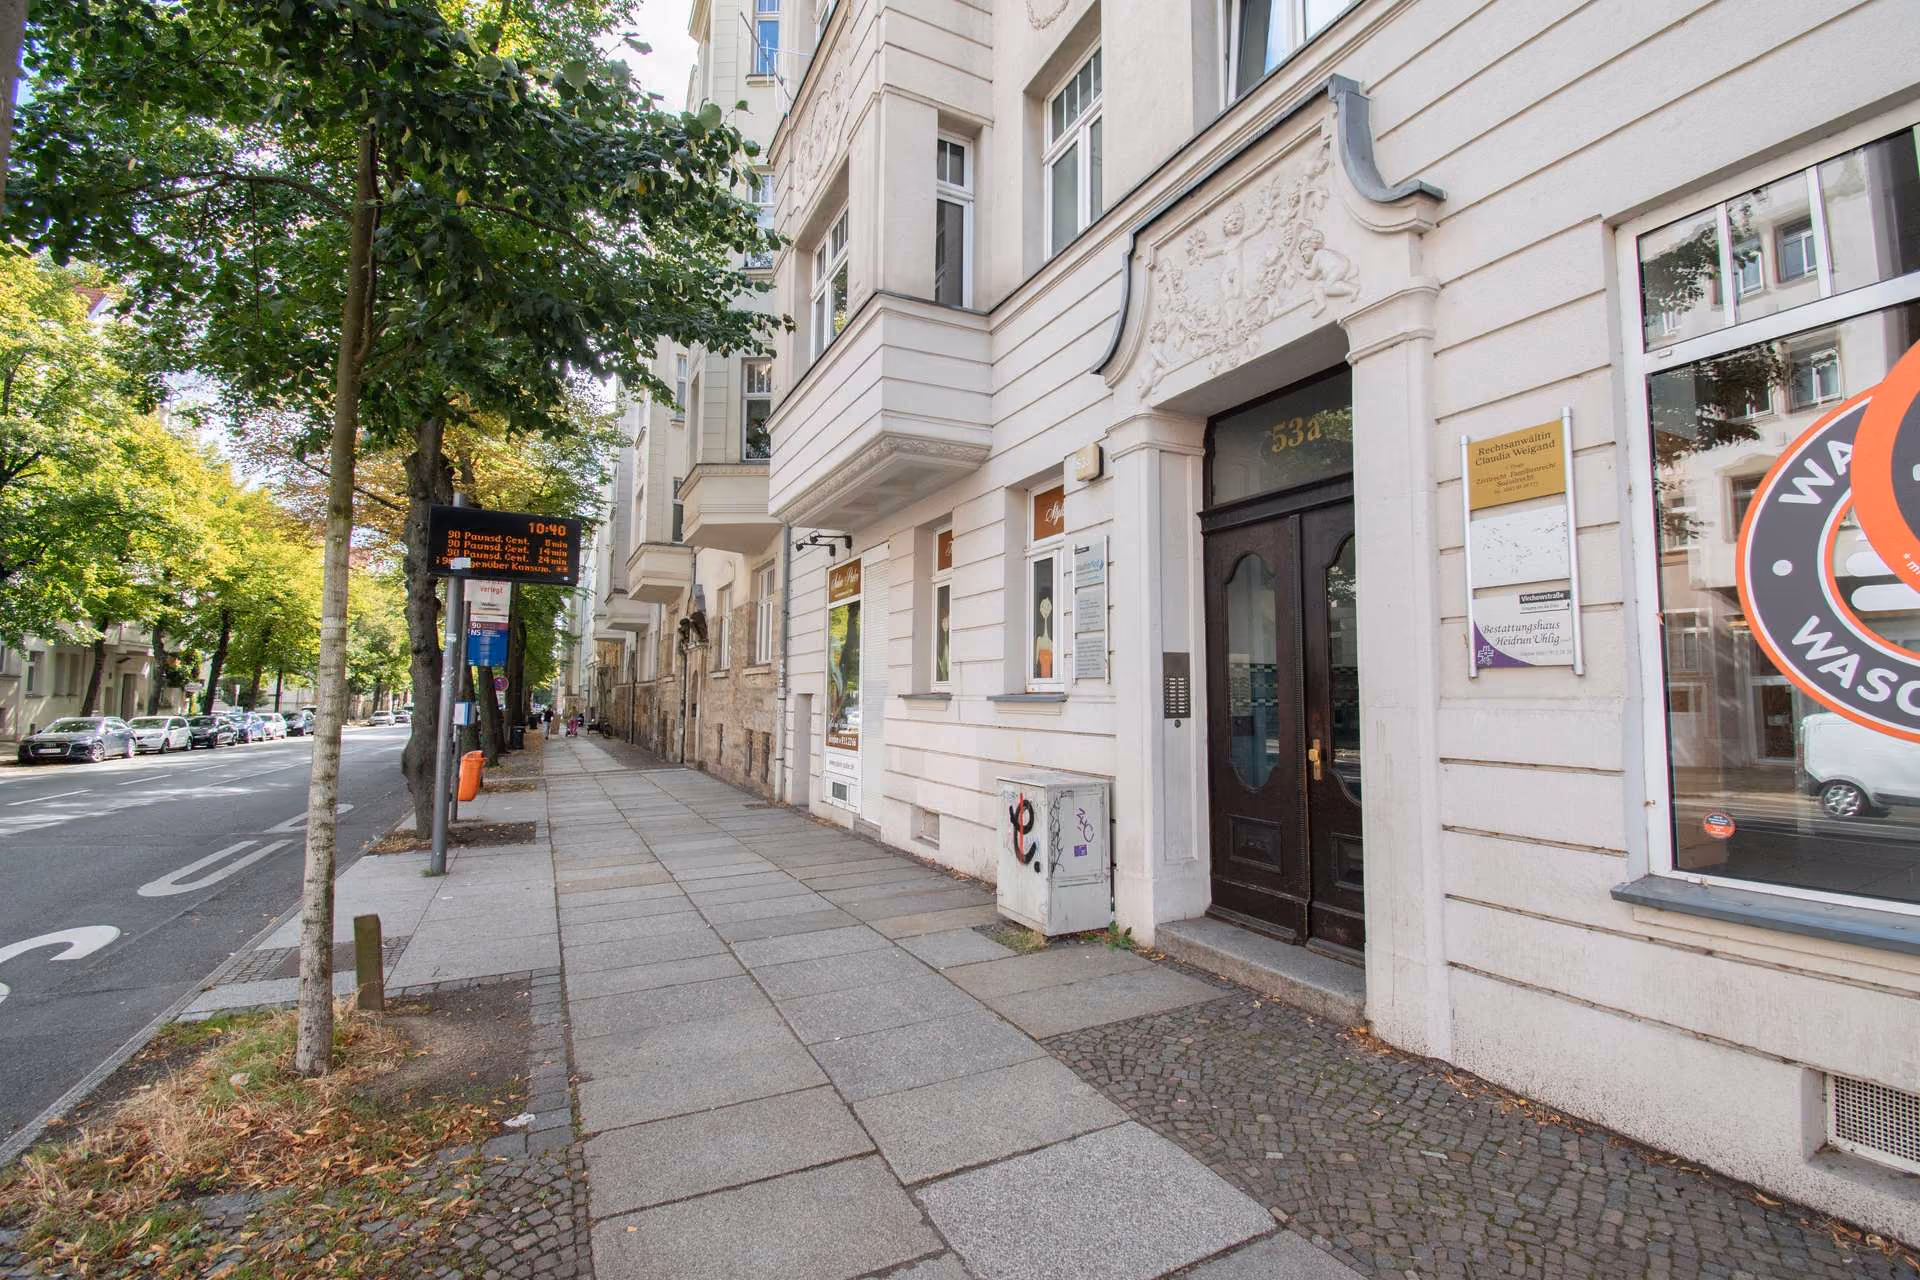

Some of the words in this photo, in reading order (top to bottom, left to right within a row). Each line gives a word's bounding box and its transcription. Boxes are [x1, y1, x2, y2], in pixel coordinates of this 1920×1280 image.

[1272, 416, 1322, 453] 53a
[1478, 431, 1551, 456] Rechtsanwältin
[1475, 451, 1511, 466] Claudia
[1513, 440, 1556, 457] Weigand
[528, 522, 567, 537] 10:40
[448, 530, 461, 539] 90
[464, 531, 503, 543] Paunsd.
[505, 535, 530, 545] Cent.
[447, 539, 460, 548] 90
[464, 540, 503, 552] Paunsd.
[505, 544, 529, 554] Cent.
[447, 548, 460, 557] 90
[464, 549, 503, 561] Paunsd.
[504, 553, 529, 563] Cent.
[1482, 619, 1561, 635] Bestattungshaus
[1495, 635, 1532, 646] Heidrun
[1532, 634, 1560, 647] Uhlig
